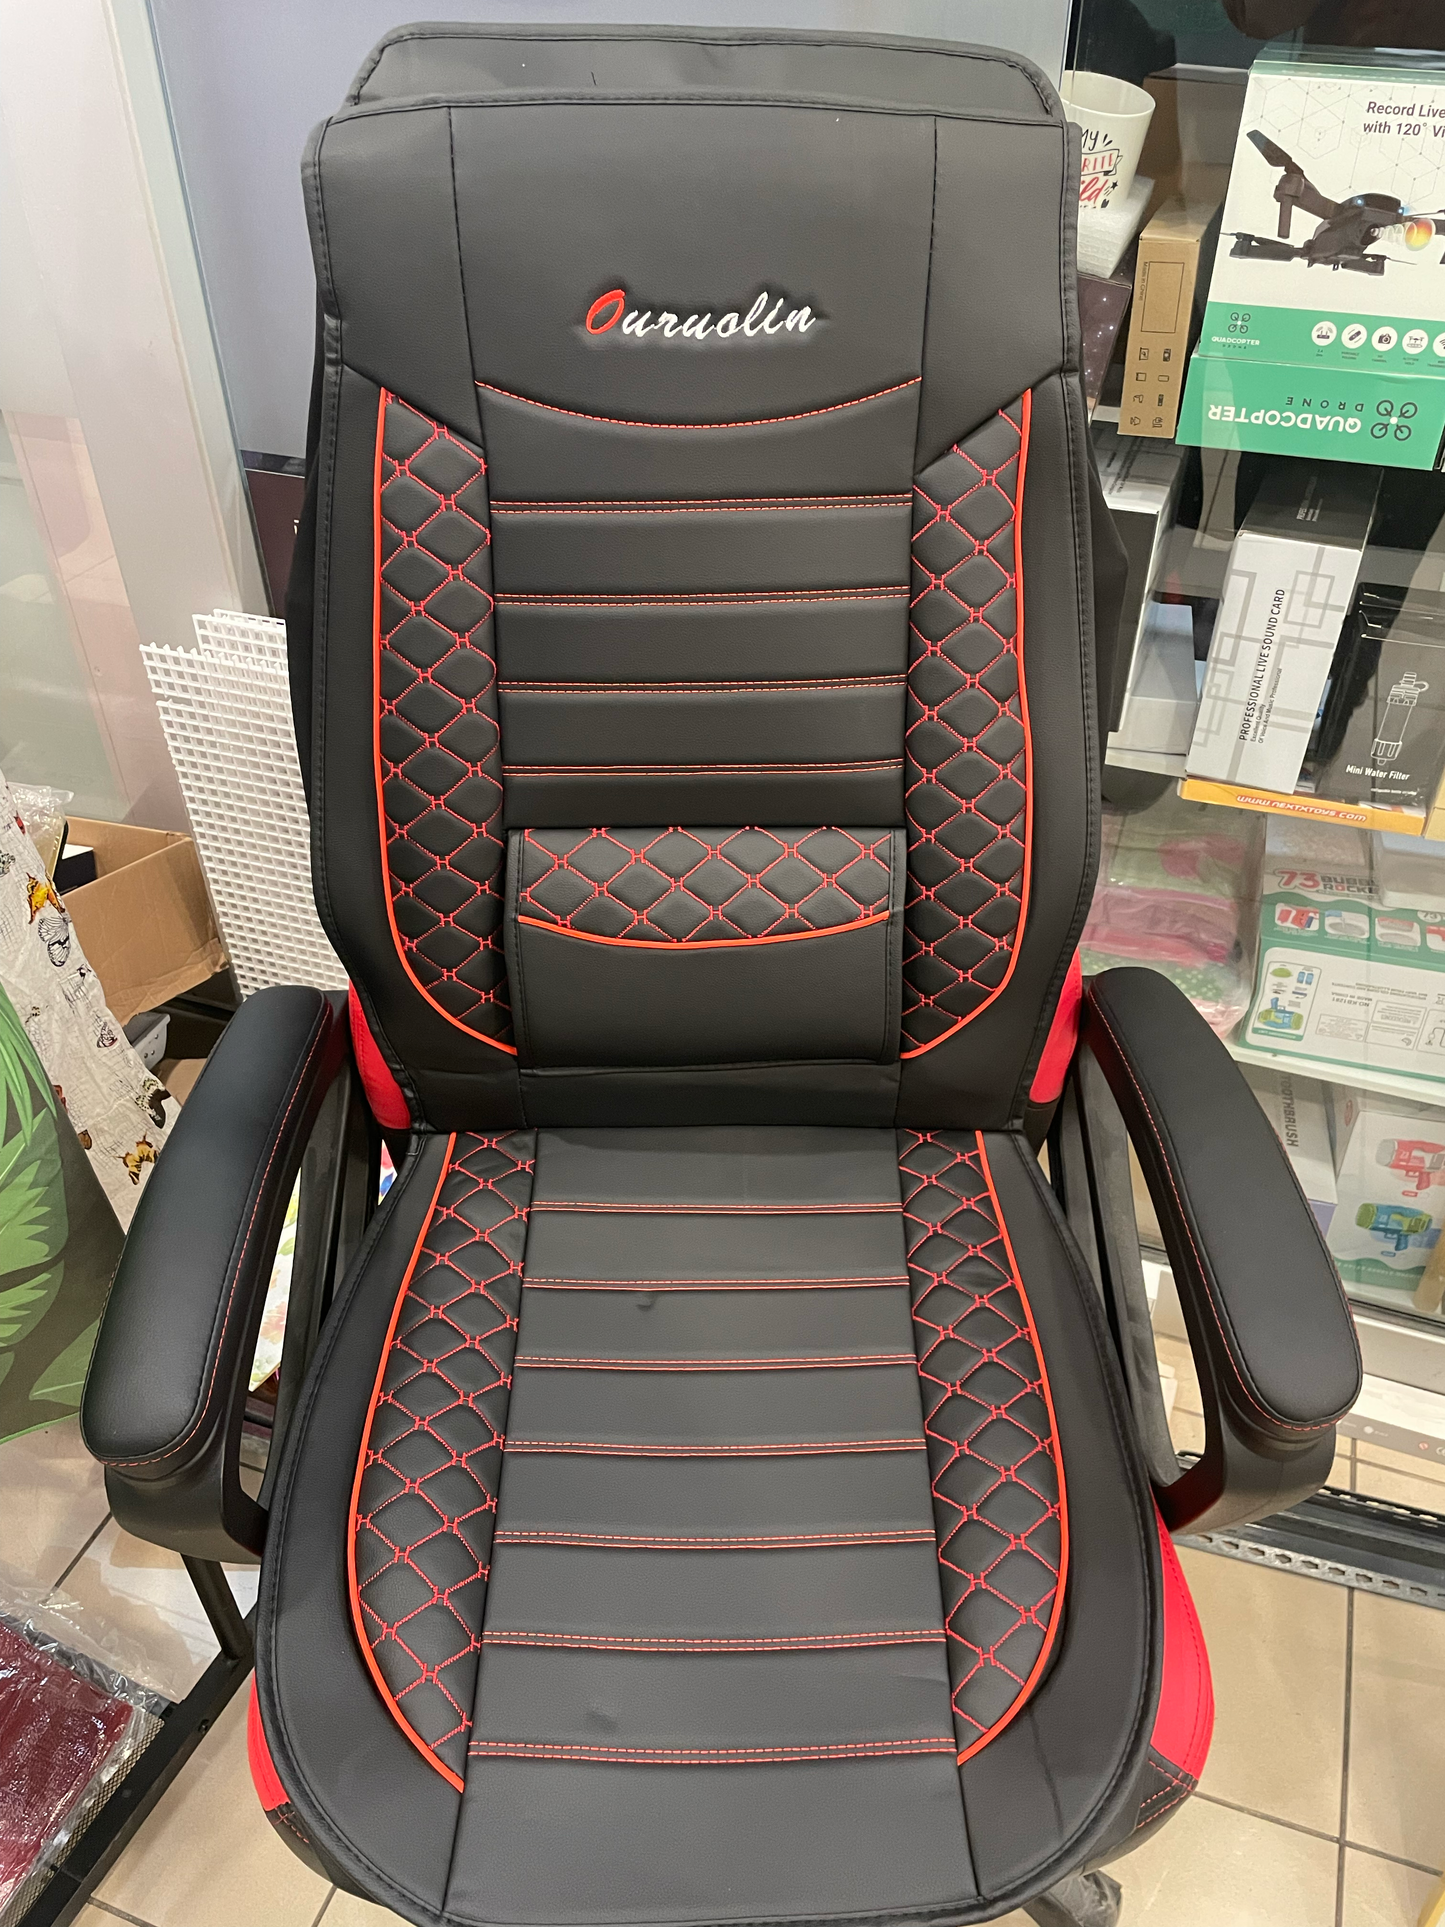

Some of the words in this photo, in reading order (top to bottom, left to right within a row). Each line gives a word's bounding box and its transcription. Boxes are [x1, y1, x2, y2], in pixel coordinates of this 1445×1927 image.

[1366, 101, 1416, 117] Record
[1418, 104, 1445, 119] Live
[1363, 120, 1391, 134] with
[1396, 122, 1428, 136] 120°
[1211, 336, 1260, 346] QUADCOPTER
[1285, 396, 1365, 412] DRONE
[1207, 404, 1362, 434] QUADCOPTER
[1271, 588, 1286, 616] CARD
[1262, 617, 1278, 651] SOUND
[1256, 652, 1270, 673] LIVE
[1270, 667, 1283, 700] Professional
[1239, 673, 1265, 741] PROFESSIONAL
[1345, 764, 1364, 775] Mini
[1365, 767, 1388, 779] Water
[1388, 770, 1411, 781] Filter
[1277, 869, 1321, 889] 73
[1280, 1075, 1299, 1147] TOOTHBRUSH
